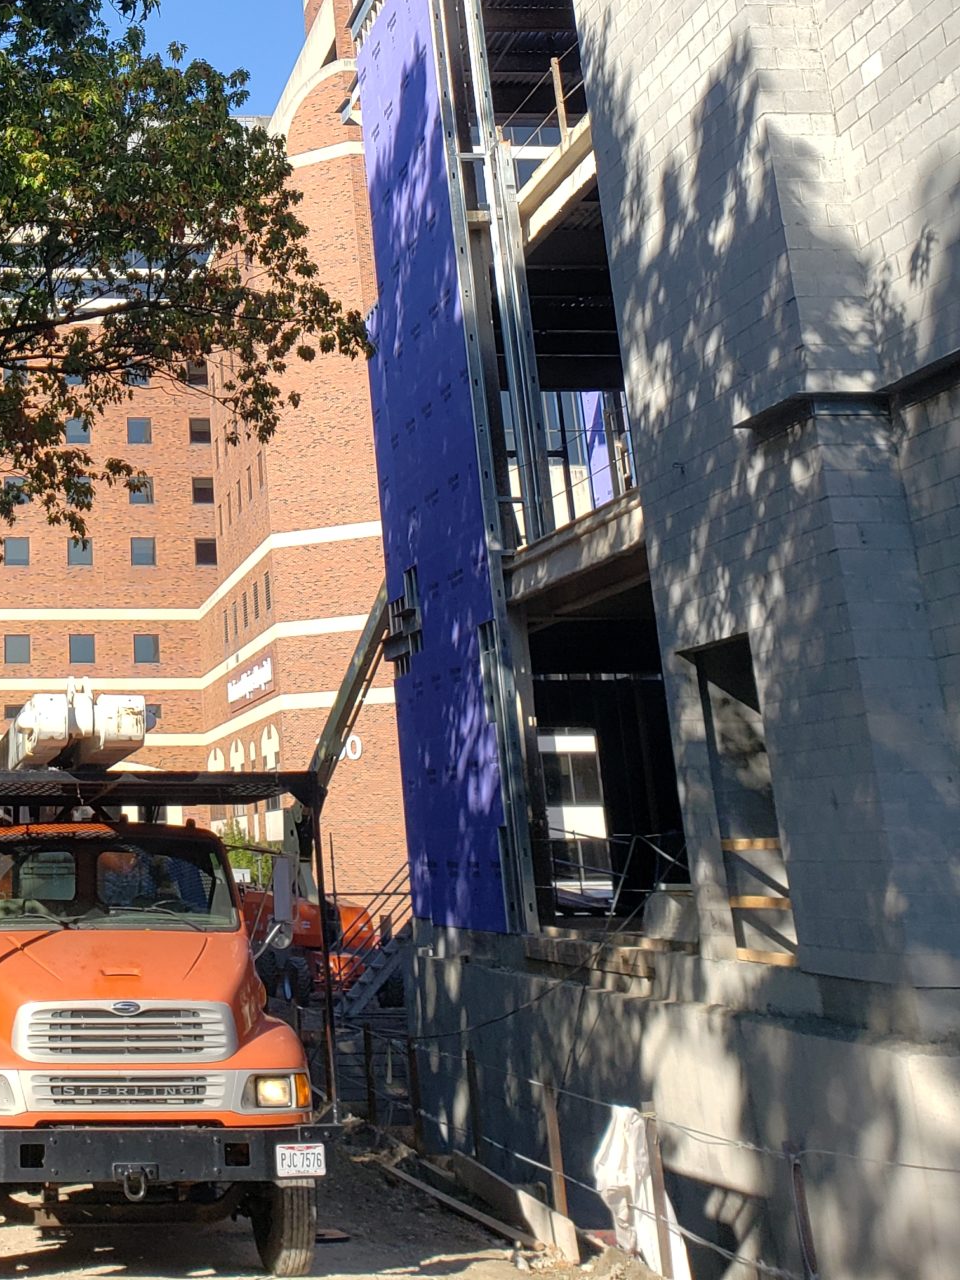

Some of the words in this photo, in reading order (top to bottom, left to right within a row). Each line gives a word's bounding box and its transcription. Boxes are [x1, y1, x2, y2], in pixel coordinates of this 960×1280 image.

[63, 1086, 194, 1096] STERLING
[280, 1152, 298, 1168] PJC
[300, 1152, 322, 1168] 7576
